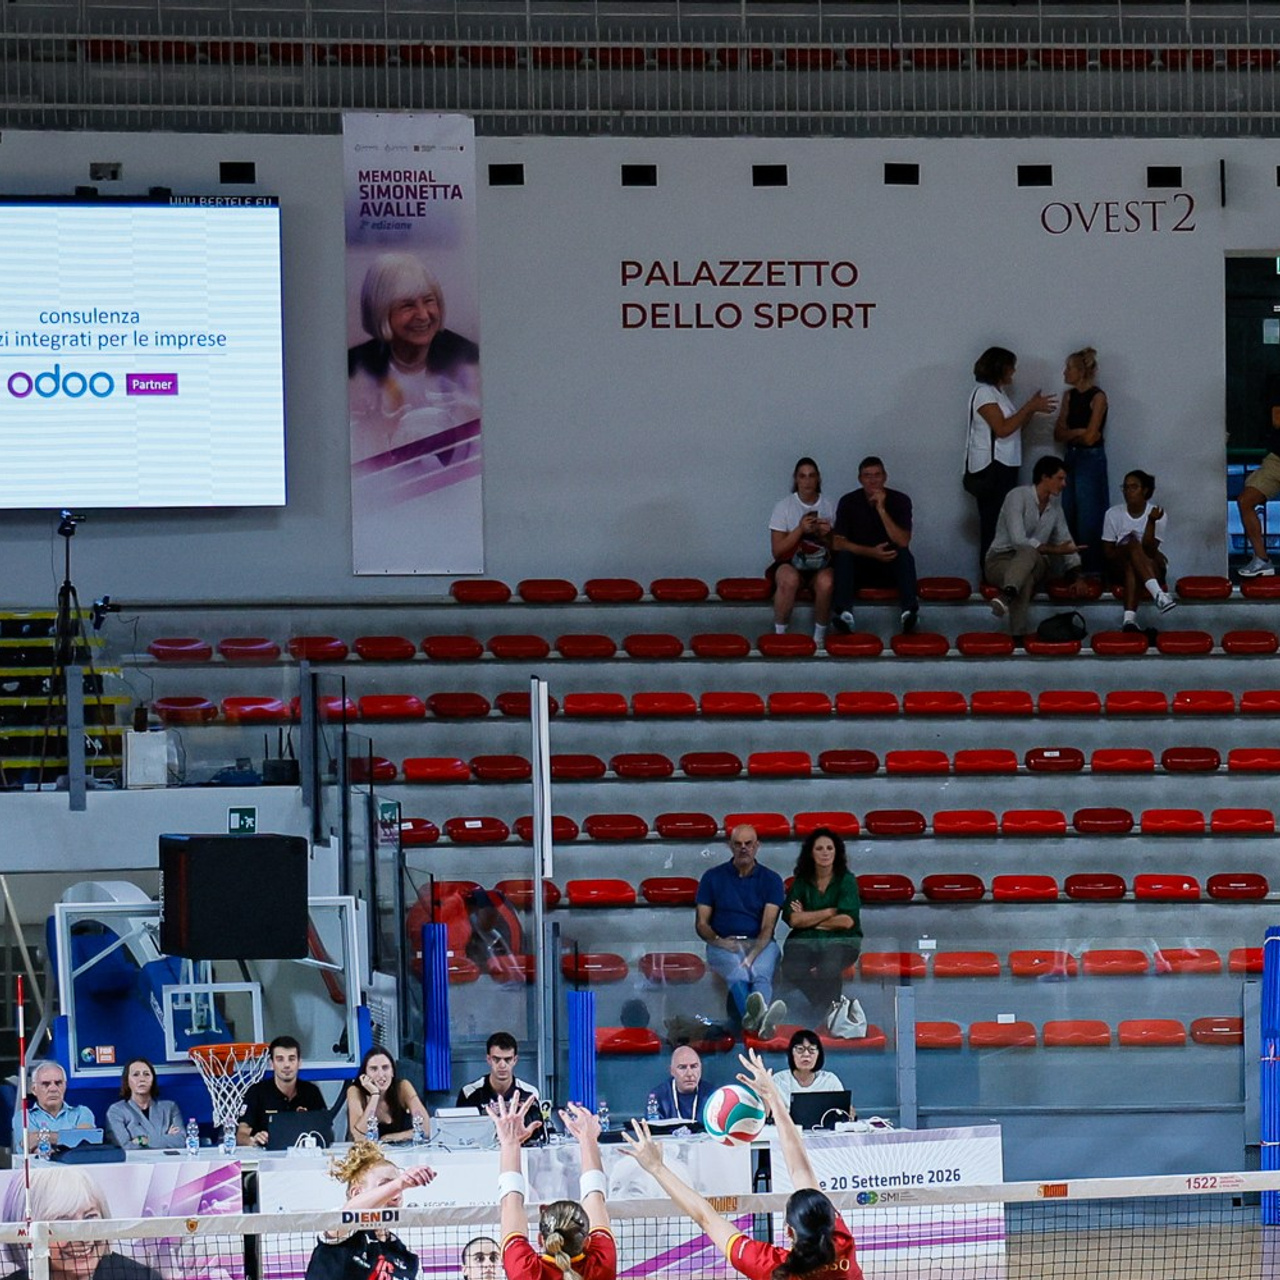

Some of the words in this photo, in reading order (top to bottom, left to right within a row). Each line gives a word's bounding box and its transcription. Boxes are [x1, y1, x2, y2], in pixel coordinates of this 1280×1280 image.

[358, 170, 436, 183] MEMORIAL
[359, 184, 463, 200] SIMONETTA
[359, 202, 427, 217] AVALLE
[1040, 201, 1166, 235] OVEST
[371, 220, 413, 231] edizione
[621, 260, 859, 288] PALAZZETTO
[39, 307, 141, 324] consulenza
[621, 302, 743, 329] DELLO
[754, 302, 877, 329] SPORT
[15, 331, 92, 350] integrati
[98, 333, 128, 350] per
[133, 330, 149, 347] le
[154, 331, 228, 349] imprese
[7, 363, 115, 398] odoo
[132, 379, 173, 390] Partner
[831, 1177, 848, 1190] 20
[851, 1172, 924, 1189] Settembre
[928, 1168, 961, 1184] 2026
[1185, 1176, 1218, 1190] 1522
[341, 1209, 399, 1224] DIENDI
